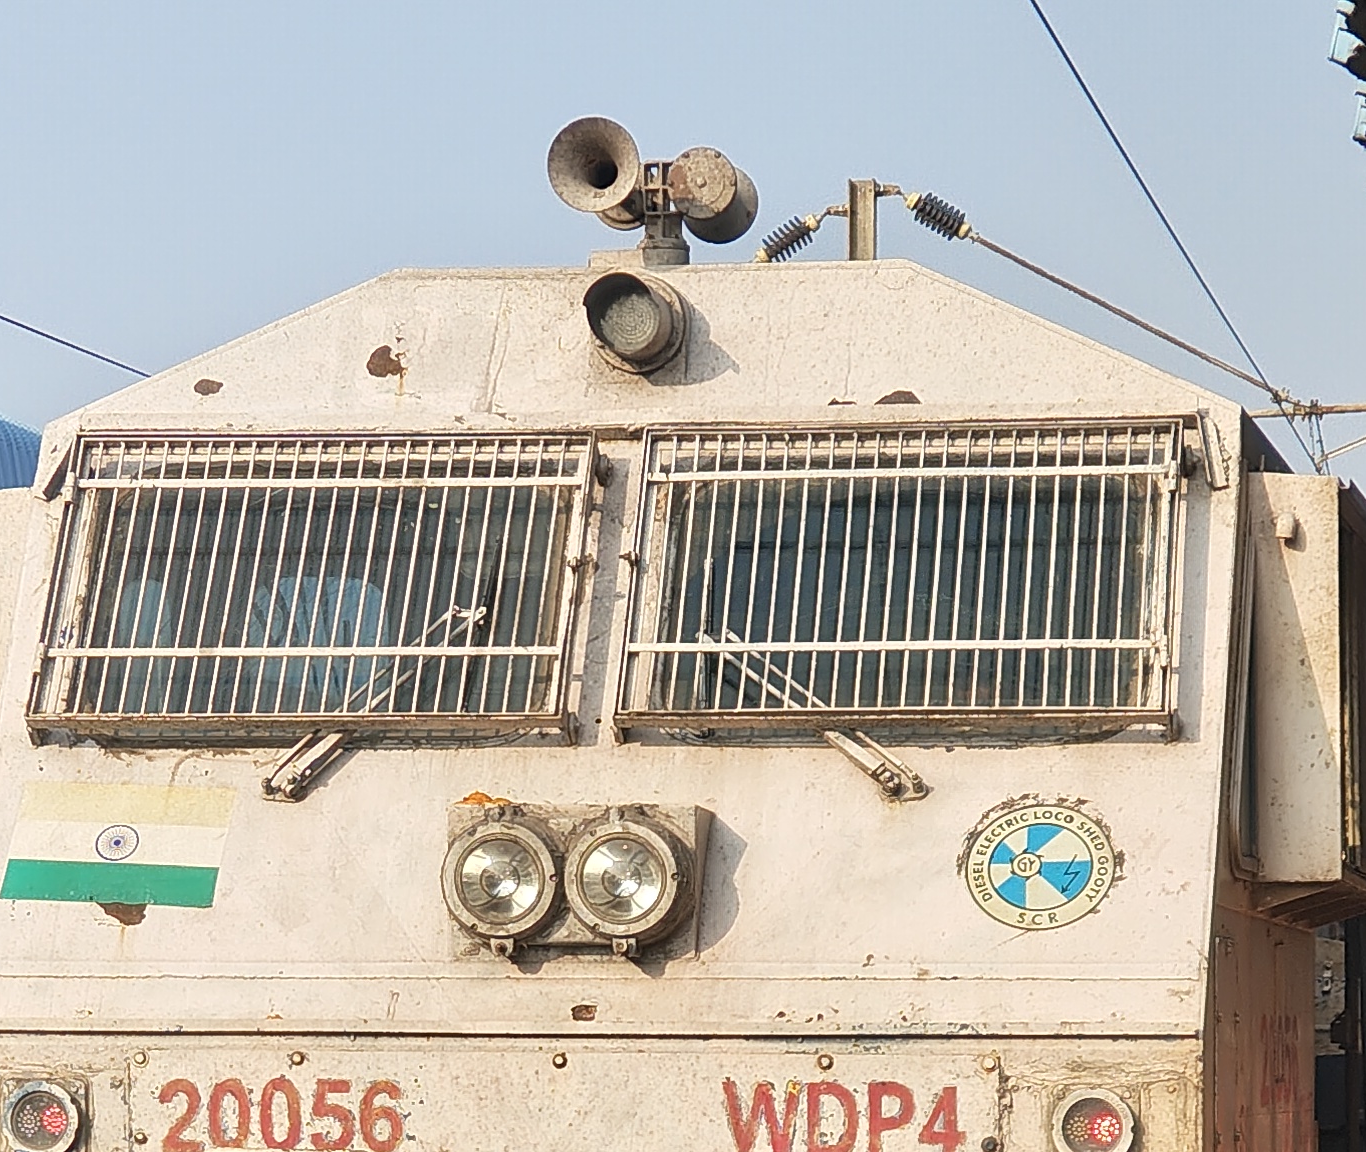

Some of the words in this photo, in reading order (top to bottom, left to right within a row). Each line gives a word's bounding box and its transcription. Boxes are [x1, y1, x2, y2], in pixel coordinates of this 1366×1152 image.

[976, 812, 1030, 856] ELECTRIC
[1033, 811, 1075, 824] LOCO
[1076, 821, 1106, 851] SHED
[972, 860, 993, 903] DIESEL
[1016, 856, 1037, 874] GY
[1085, 856, 1110, 903] GOOTY
